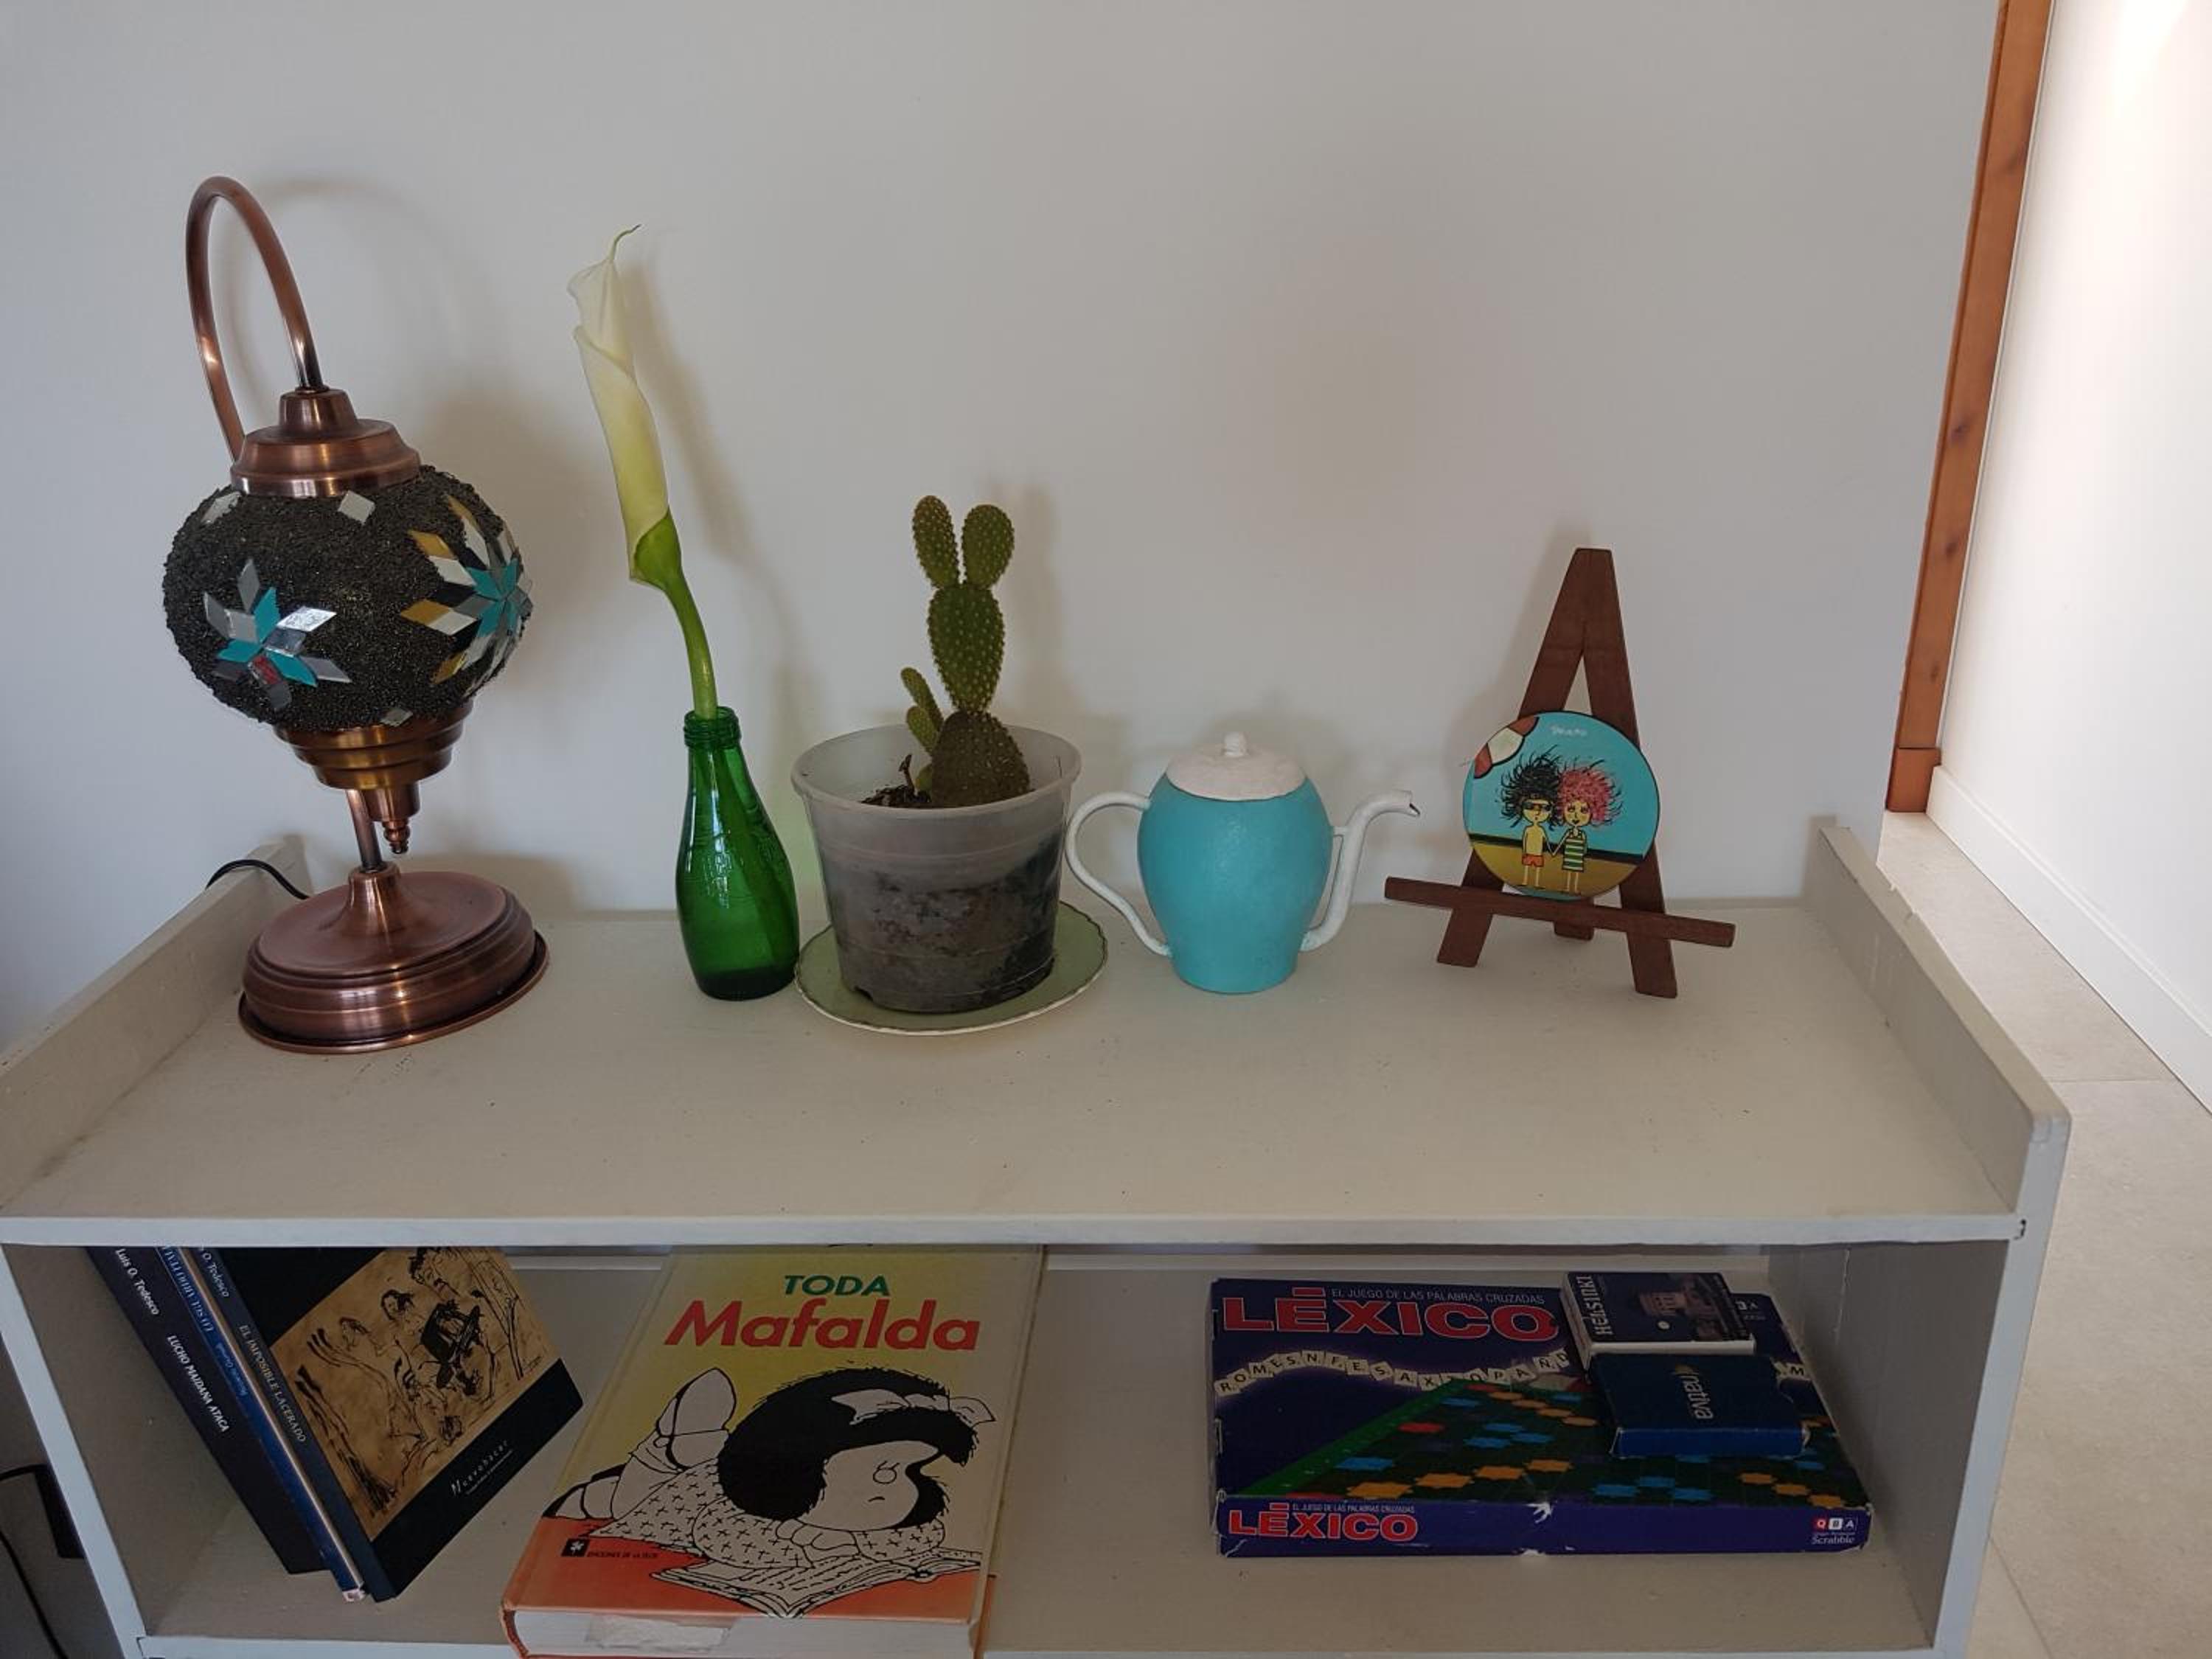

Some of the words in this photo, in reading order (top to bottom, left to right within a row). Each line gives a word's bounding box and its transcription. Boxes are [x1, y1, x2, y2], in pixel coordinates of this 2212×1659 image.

[115, 1248, 131, 1267] Luis
[133, 1279, 160, 1315] Tedesco
[209, 1263, 230, 1298] Tedesco
[784, 1275, 891, 1296] TODA
[1332, 1290, 1345, 1298] EL
[1348, 1290, 1382, 1299] JUEGO
[1385, 1290, 1399, 1299] DE
[1403, 1291, 1424, 1301] LAS
[1427, 1292, 1483, 1303] PALABRAS
[1486, 1293, 1546, 1304] CRUZADAS
[664, 1298, 981, 1350] Mafalda
[1222, 1287, 1559, 1342] LÉXICO
[167, 1335, 190, 1364] LUCHO
[185, 1364, 213, 1405] MAIDANA
[207, 1404, 230, 1433] ATACA
[238, 1324, 253, 1339] EL
[248, 1338, 279, 1390] IMPOSIBLE
[273, 1391, 307, 1443] LACERADO
[1682, 1373, 1714, 1420] nativa
[1228, 1503, 1418, 1541] LÉXICO
